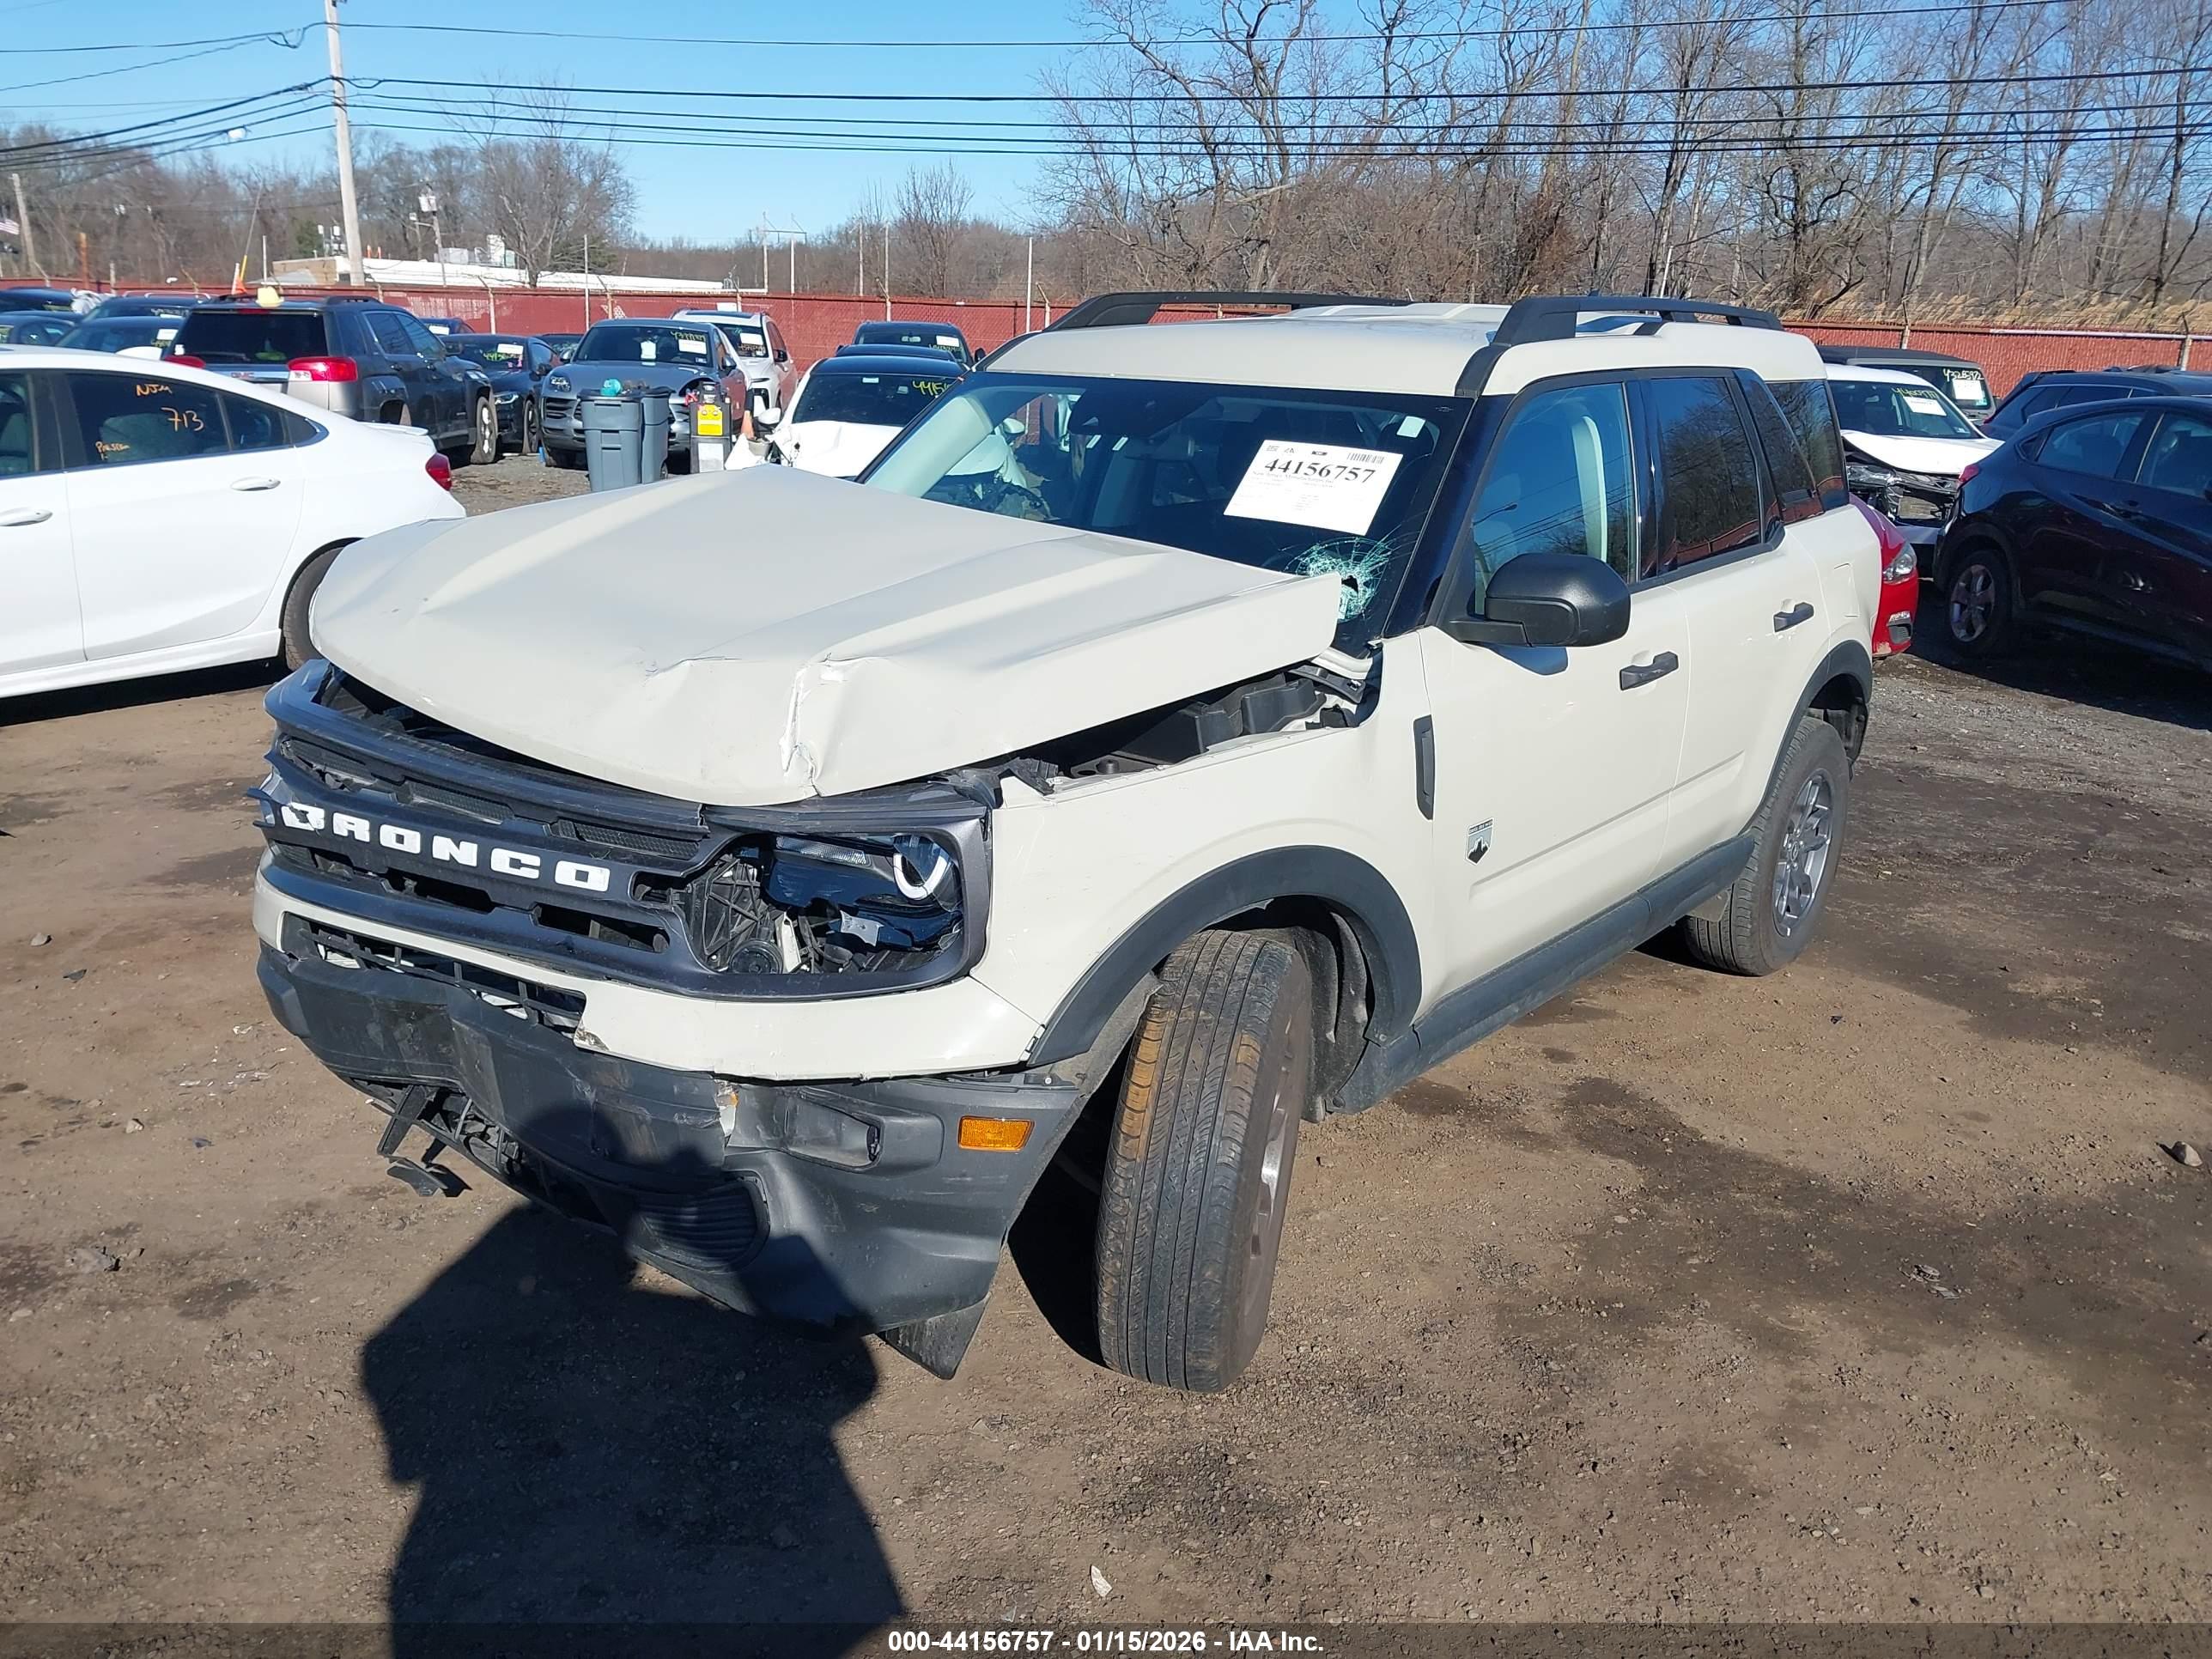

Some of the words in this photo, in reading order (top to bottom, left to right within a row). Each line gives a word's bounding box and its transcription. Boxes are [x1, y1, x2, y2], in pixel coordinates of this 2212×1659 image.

[161, 407, 204, 432] 713
[1264, 458, 1376, 483] 44156757
[280, 801, 611, 892] BRONCO
